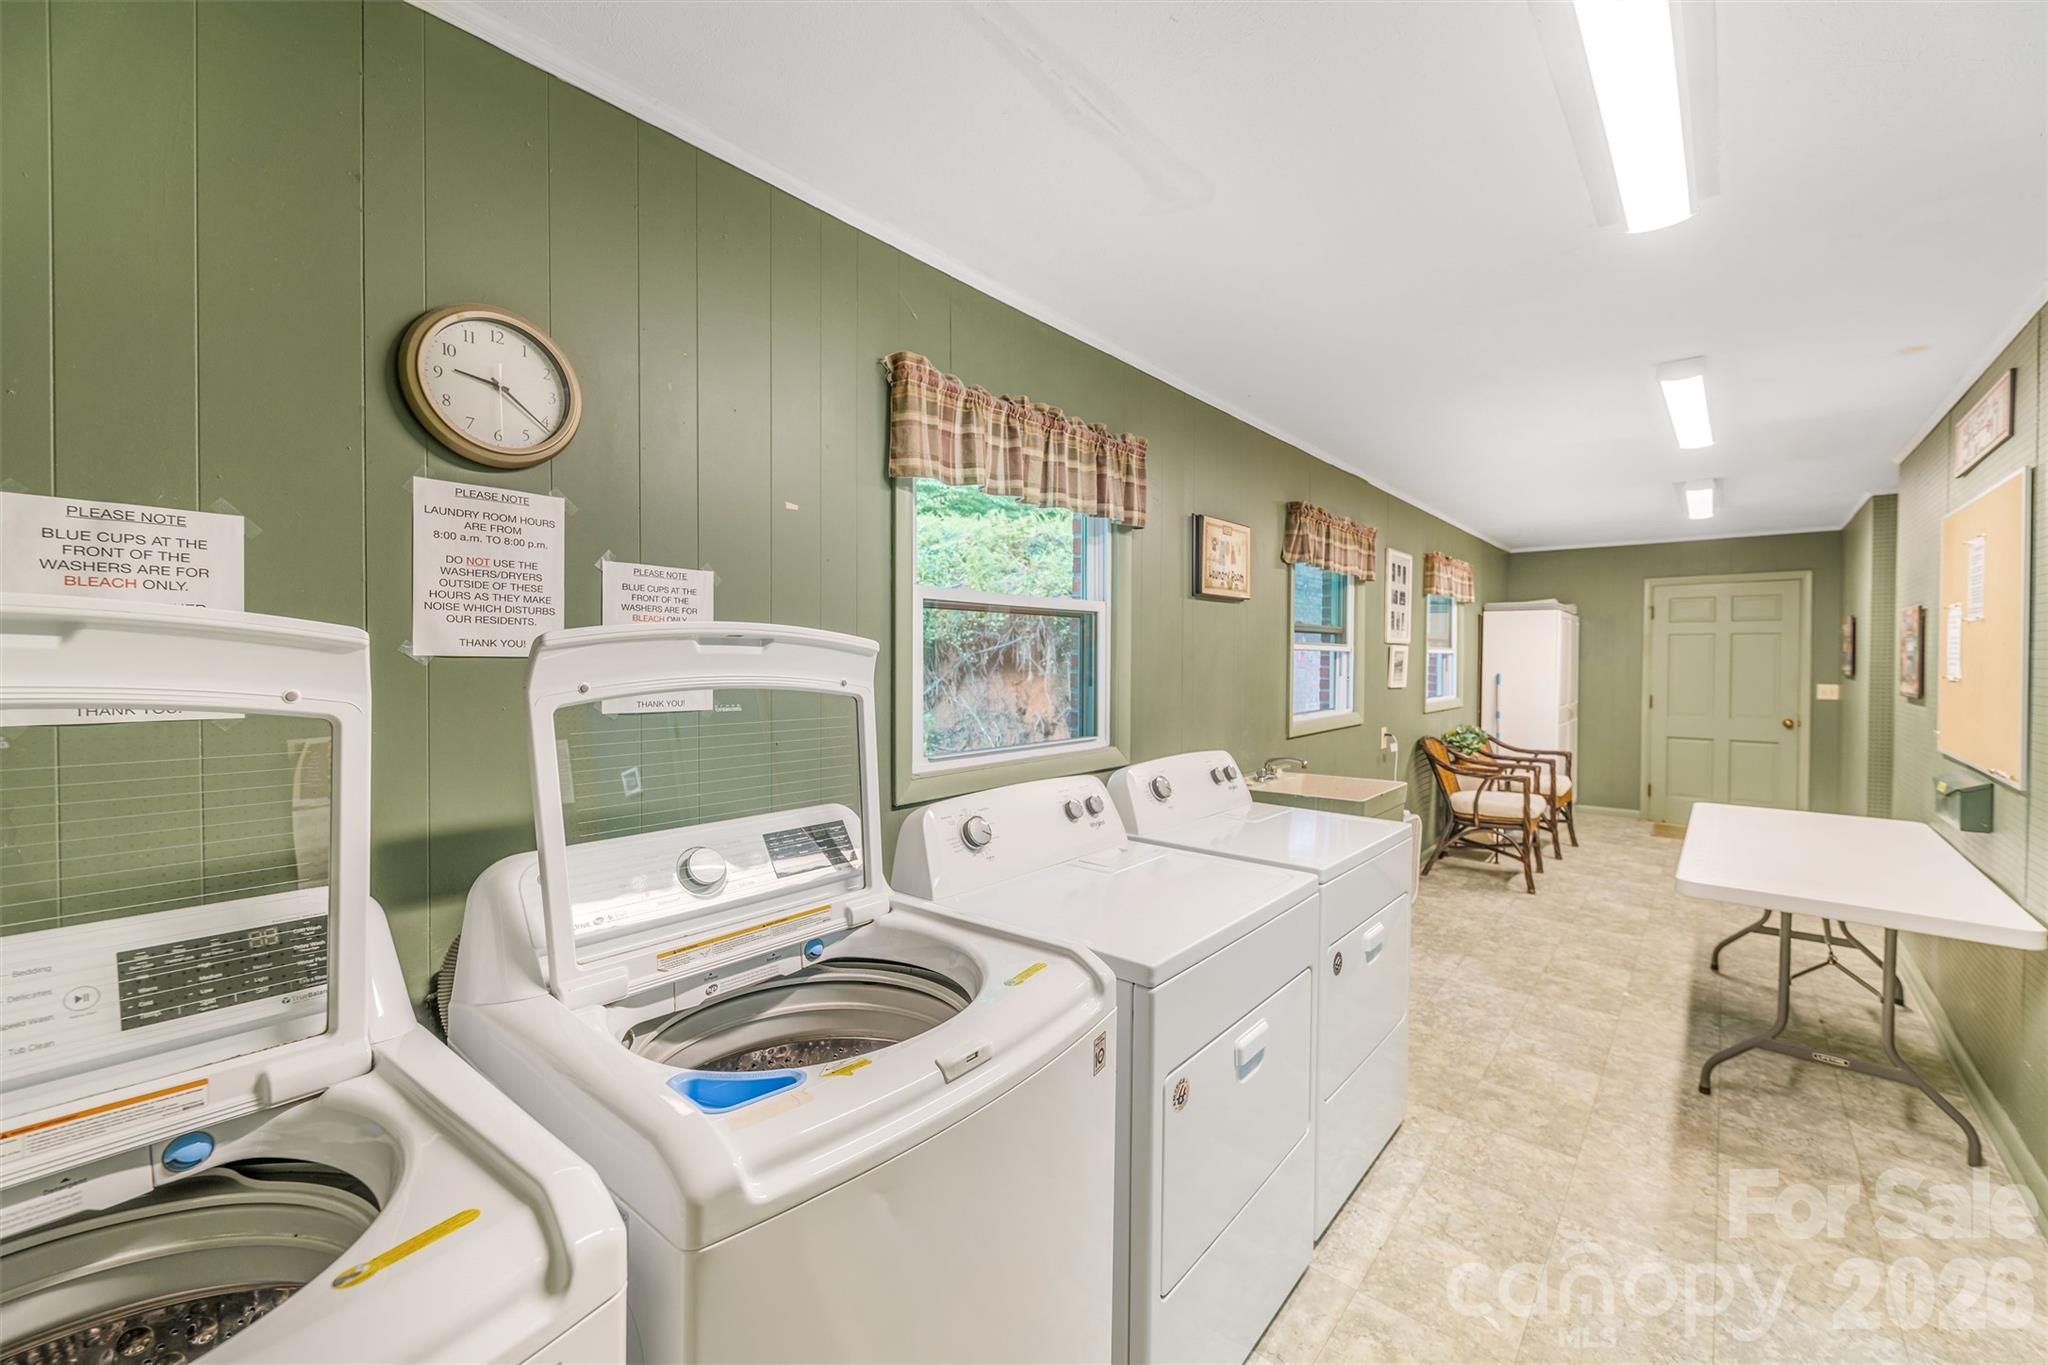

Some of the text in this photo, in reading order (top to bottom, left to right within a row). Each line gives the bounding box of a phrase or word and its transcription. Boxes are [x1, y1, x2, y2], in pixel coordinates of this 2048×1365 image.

[464, 329, 475, 344] 11
[491, 330, 504, 345] 12
[442, 342, 457, 357] 10
[522, 345, 527, 357] 1
[433, 365, 443, 378] 9
[544, 368, 551, 380] 2
[442, 393, 451, 407] 8
[548, 392, 556, 405] 3
[465, 416, 475, 429] 7
[494, 429, 503, 441] 6
[522, 429, 530, 440] 5
[455, 488, 529, 506] PLEASE NOTE
[66, 505, 187, 527] PLEASE NOTE
[424, 505, 555, 528] LAUNDRY ROOM HOURS
[464, 522, 522, 535] ARE FROM
[41, 528, 208, 550] BLUE CUPS AT THE
[433, 530, 548, 550] 8:00 a.m. TO 8:00 p.m.
[62, 545, 191, 563] FRONT OF THE
[39, 559, 209, 578] WASHERS ARE FOR
[445, 555, 538, 570] DO NOT USE THE
[440, 567, 543, 582] WASHERS/DRYERS
[633, 568, 688, 581] PLEASE NOTE
[64, 576, 188, 591] BLEACH ONLY.
[439, 578, 543, 593] OUTSIDE OF THESE
[622, 583, 645, 592] BLUE
[647, 585, 669, 593] CUPS
[429, 590, 552, 604] HOURS AS THEY MAKE
[631, 594, 659, 602] FRONT
[673, 597, 689, 605] THE
[424, 601, 556, 616] NOISE WHICH DISTURBS
[621, 603, 698, 615] WASHERS ARE FOR
[446, 614, 537, 626] OUR RESIDENTS.
[632, 614, 665, 622] BLEACH
[459, 638, 526, 648] THANK YOU!
[665, 700, 686, 708] YOU!
